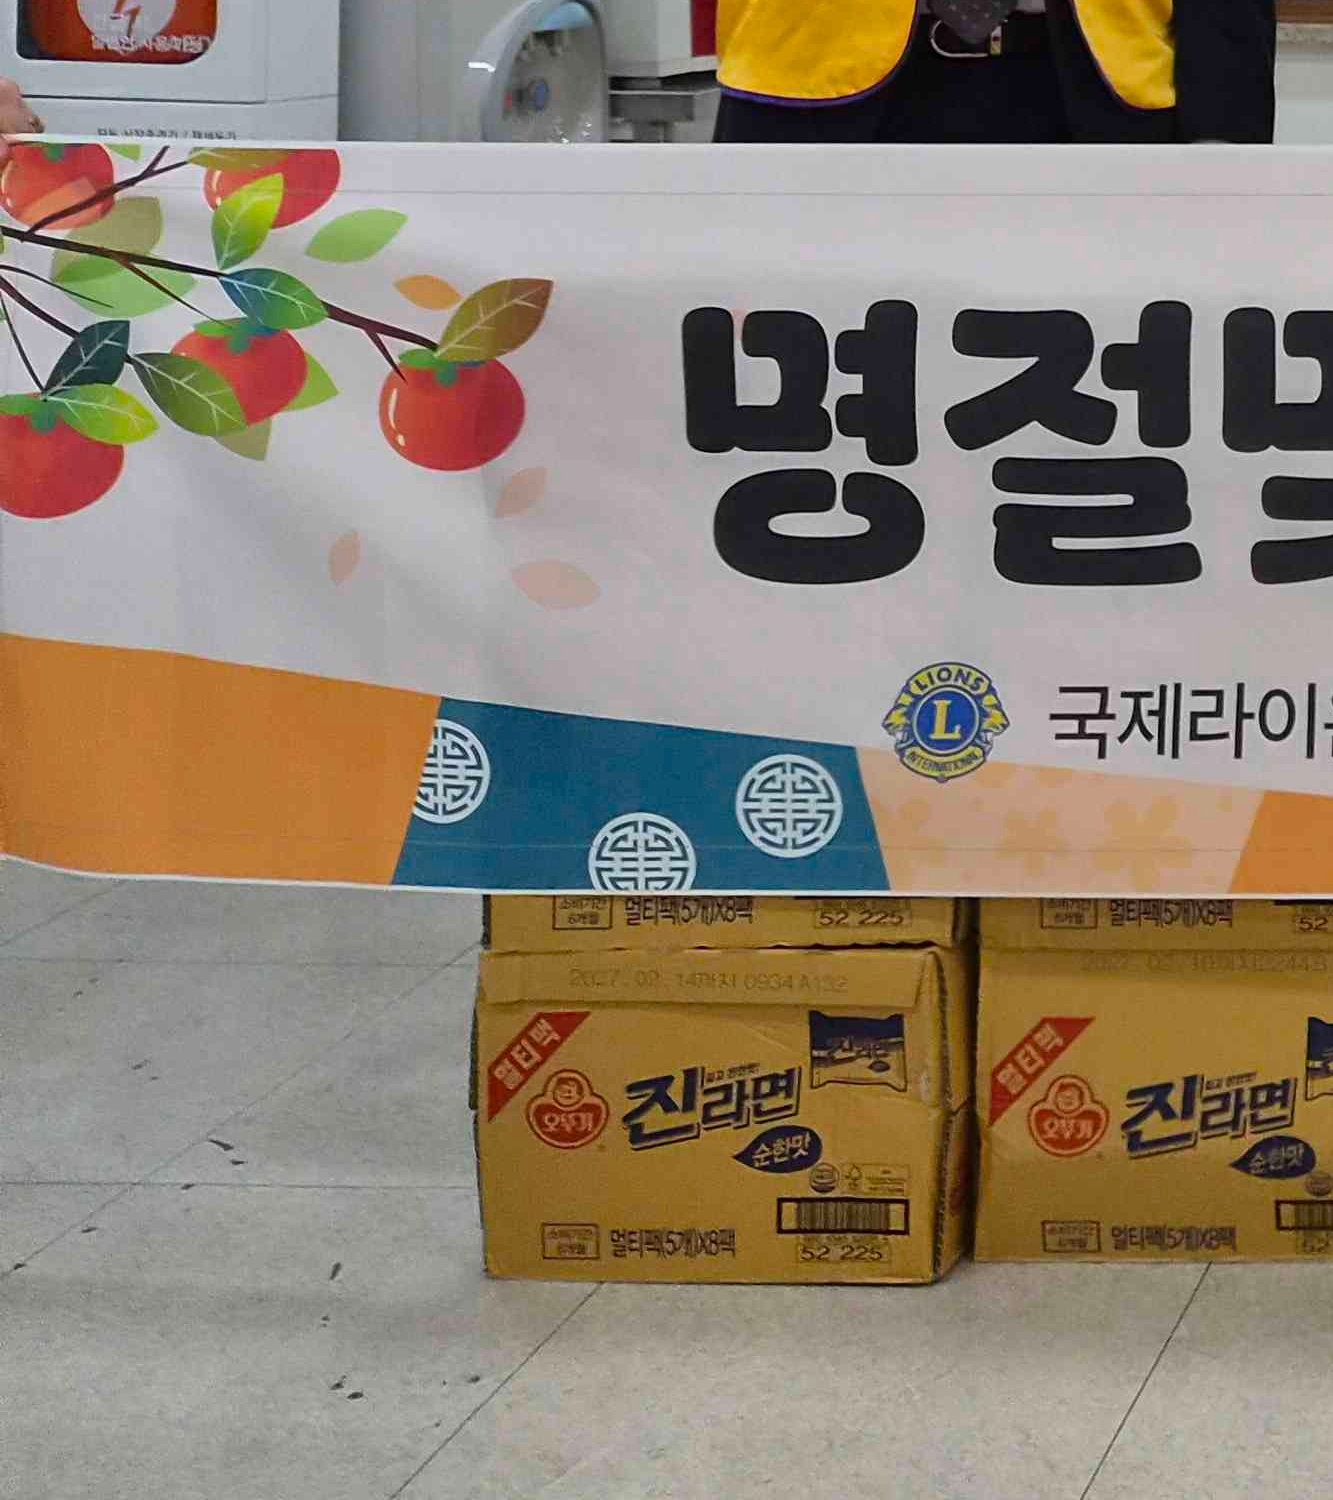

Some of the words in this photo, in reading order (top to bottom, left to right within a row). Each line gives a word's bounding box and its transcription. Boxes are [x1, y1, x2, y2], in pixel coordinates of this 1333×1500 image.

[914, 667, 985, 692] LIONS
[929, 699, 961, 739] L
[819, 912, 849, 926] 52
[859, 912, 904, 926] 225
[1300, 917, 1327, 932] 52
[623, 1065, 802, 1151] 진라면
[1120, 1074, 1297, 1160] 진라면
[752, 1132, 811, 1168] 순한맛
[801, 1245, 829, 1261] 52
[841, 1245, 883, 1261] 225
